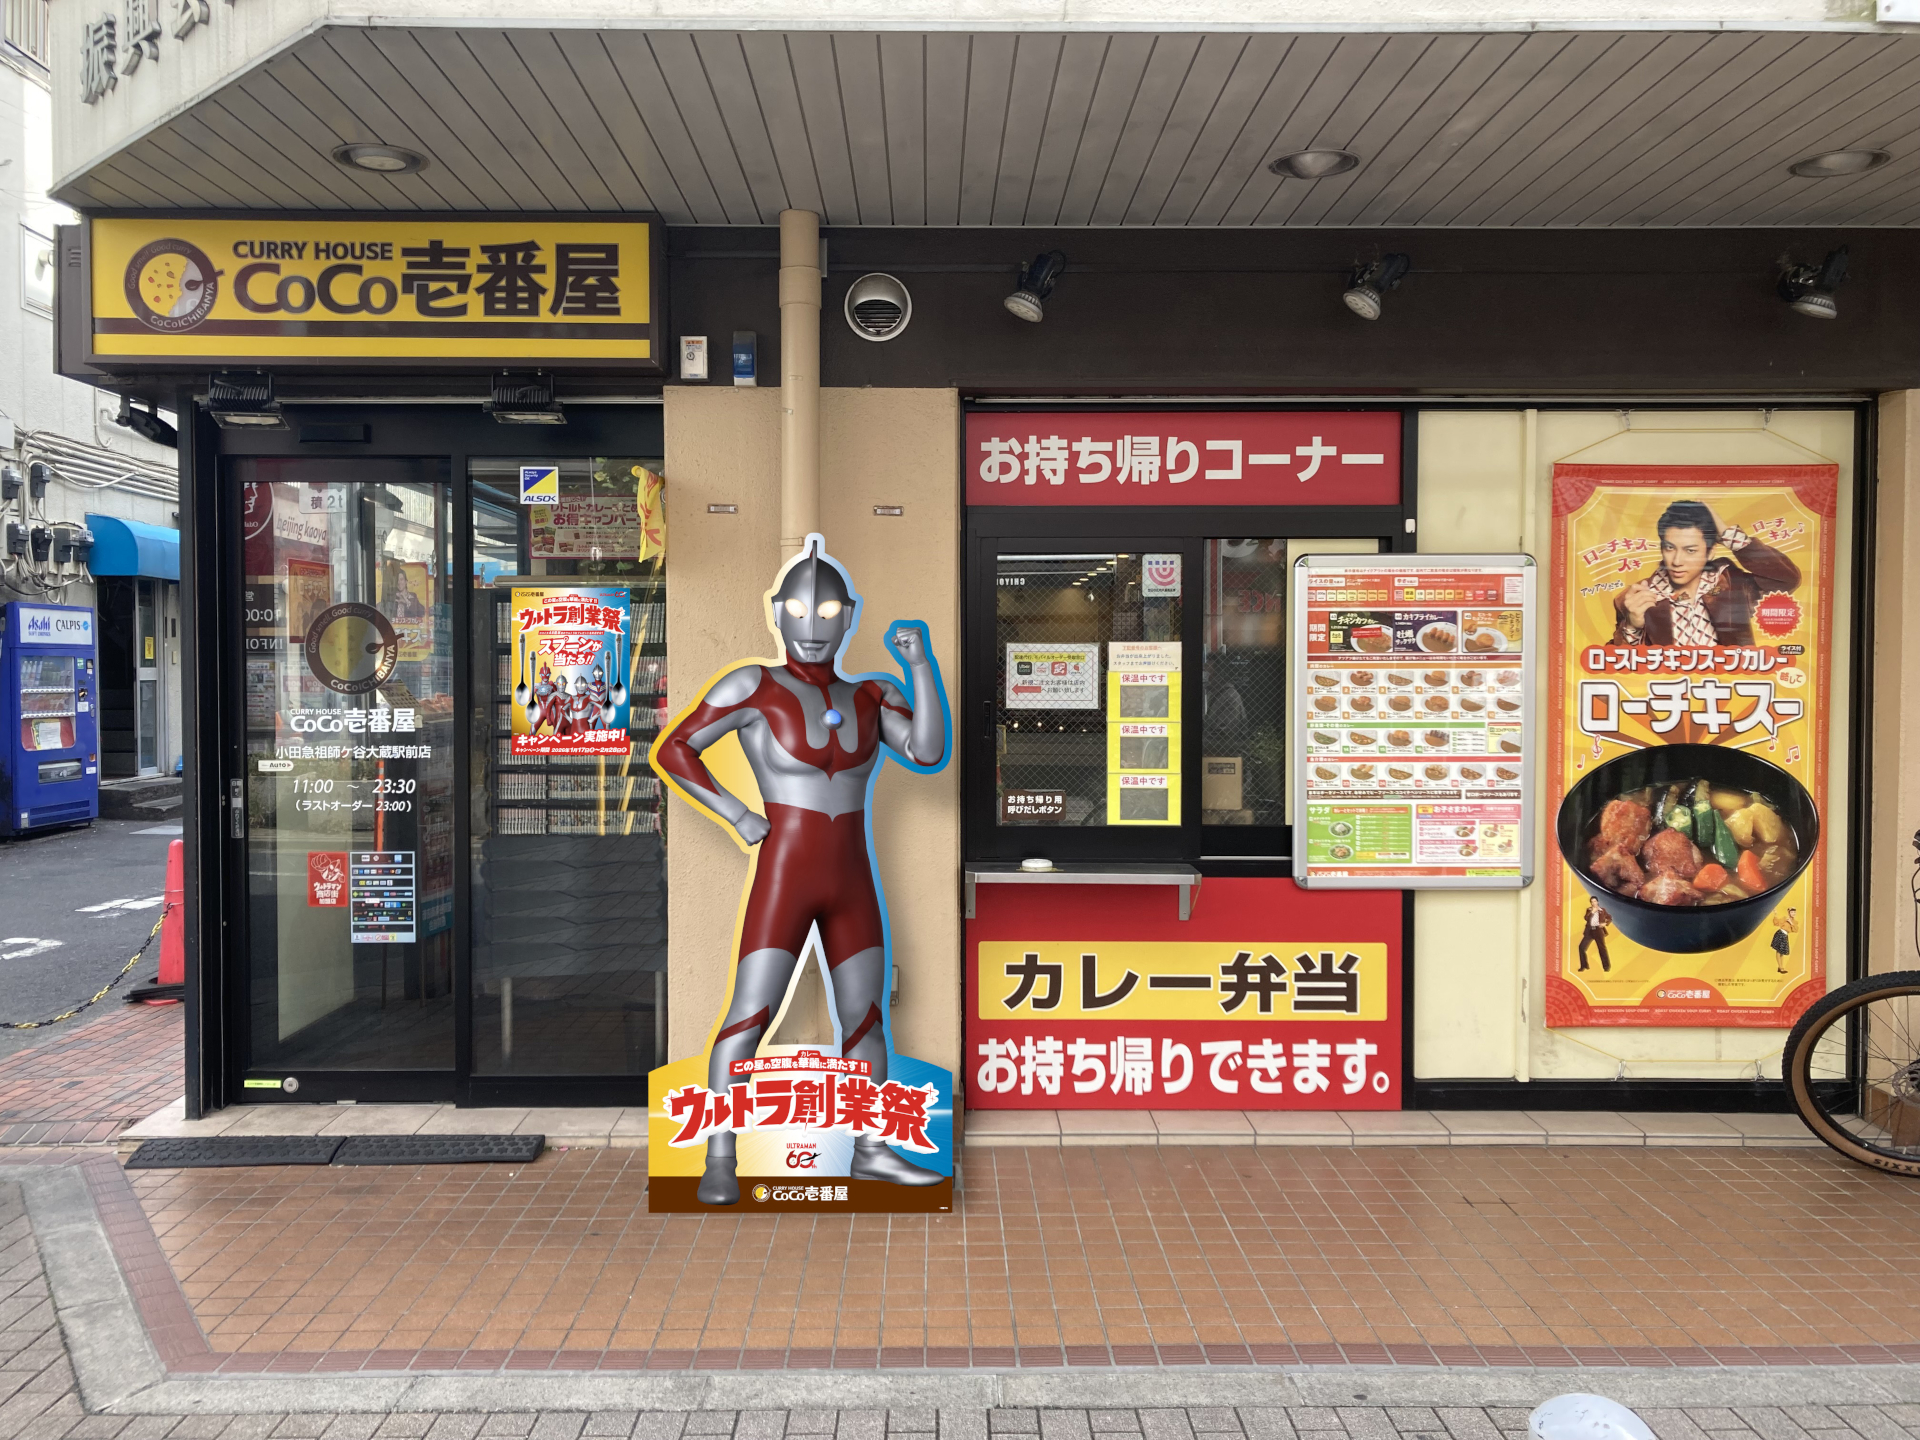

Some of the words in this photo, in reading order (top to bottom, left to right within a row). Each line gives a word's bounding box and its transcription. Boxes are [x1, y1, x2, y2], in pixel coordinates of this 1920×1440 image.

[232, 240, 309, 261] CURRY
[314, 241, 394, 262] HOUSE
[233, 239, 621, 318] CoCo壱番屋
[979, 434, 1385, 486] お持ち帰りコーナー
[523, 495, 557, 503] ALSOK
[275, 516, 304, 541] beijing
[304, 520, 327, 543] kaoya
[1752, 517, 1785, 533] ローチ
[1582, 538, 1657, 566] ローチキスー
[1617, 558, 1641, 572] スキ
[519, 604, 625, 634] ウルトラ創業祭
[1761, 608, 1796, 617] 期間限定
[28, 615, 51, 631] Asahi
[55, 619, 80, 632] CALPIS
[308, 632, 319, 654] Good
[331, 605, 353, 618] Good
[538, 637, 603, 655] スプーンが
[1588, 648, 1788, 672] ローストチキンスープカレー
[1121, 673, 1166, 683] 保温中です
[1580, 678, 1801, 734] ローチキスー
[290, 708, 416, 733] CoCo壱番屋
[1121, 725, 1166, 735] 保温中です
[293, 779, 334, 794] 11:00
[372, 779, 416, 794] 23:30
[1121, 776, 1166, 786] 保温中です
[1007, 795, 1063, 804] お持ち帰り用
[1007, 805, 1063, 814] 呼びだしボタン
[1308, 806, 1331, 814] サラダ
[1433, 805, 1482, 813] お子さまカレー
[1001, 951, 1361, 1015] カレー弁当
[977, 1036, 1390, 1096] お持ち帰りできます。
[668, 1074, 939, 1150] ウルトラ創業祭
[772, 1185, 849, 1201] CoCo壱番屋
